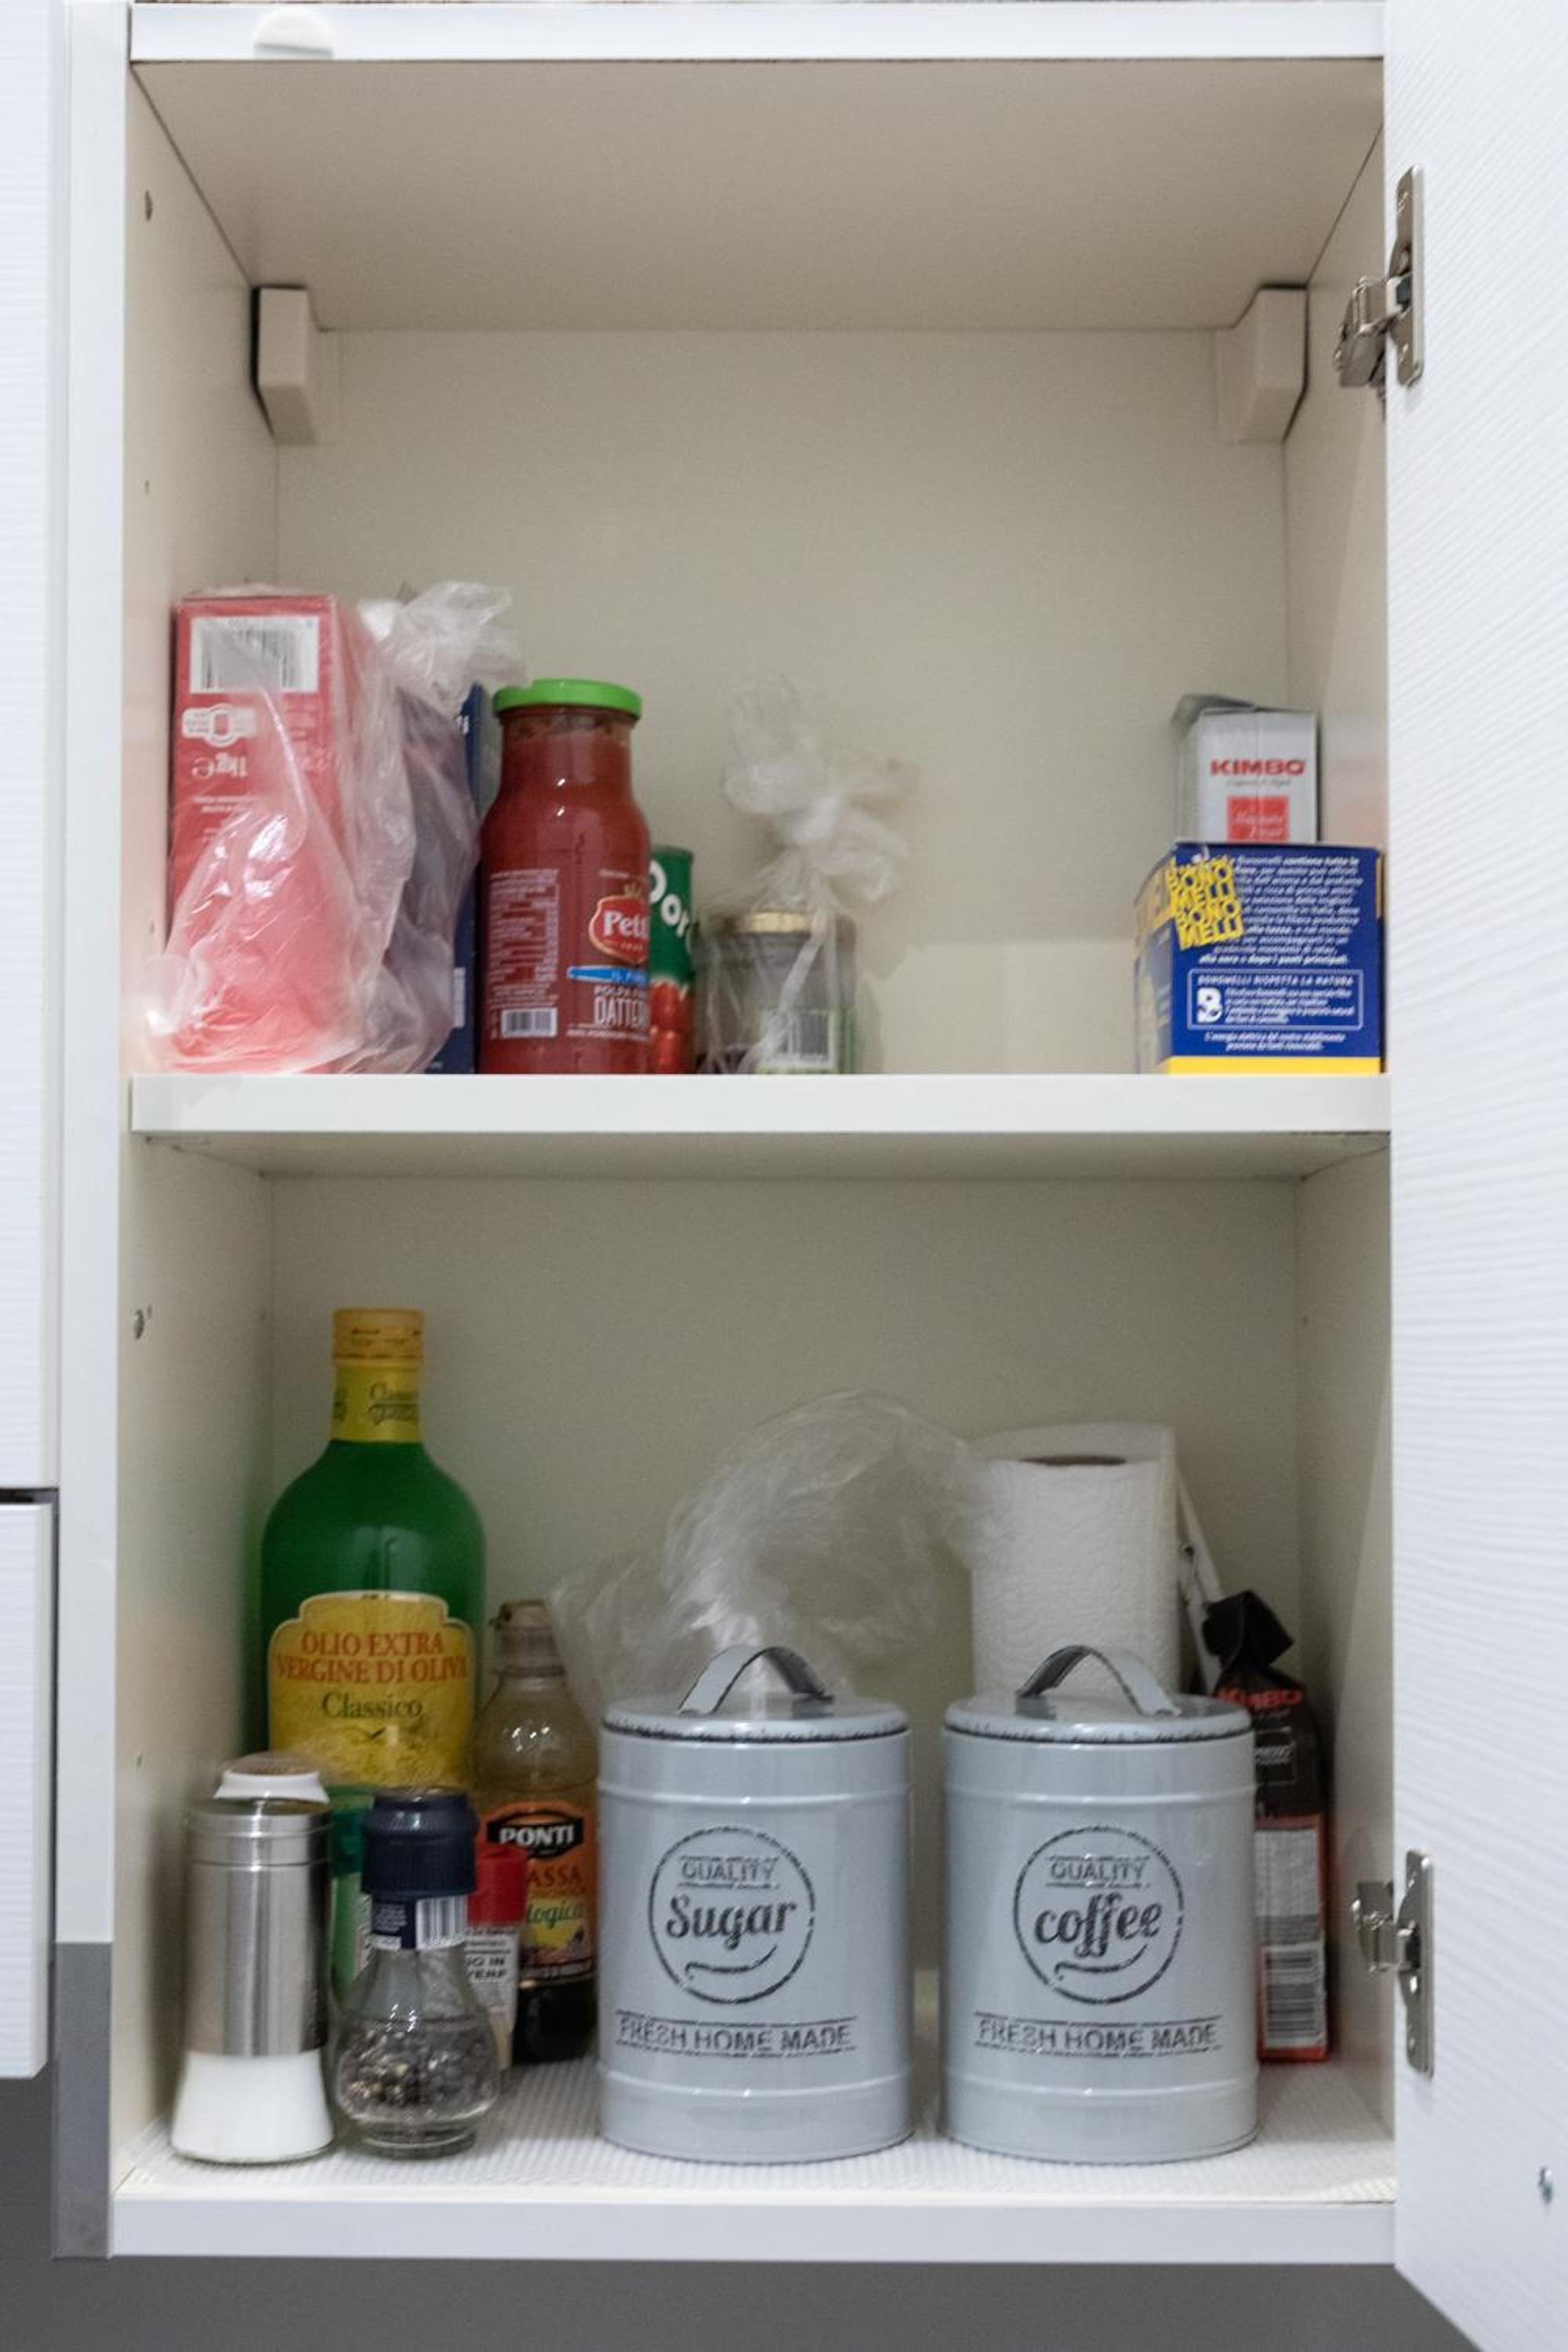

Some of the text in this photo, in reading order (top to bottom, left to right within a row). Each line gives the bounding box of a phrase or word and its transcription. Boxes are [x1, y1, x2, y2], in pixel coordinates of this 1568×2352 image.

[1210, 759, 1305, 777] KIMBO
[301, 1630, 445, 1657] OLIO EXTRA
[276, 1654, 370, 1683] VERGINE
[376, 1658, 405, 1683] DI
[322, 1691, 424, 1719] Classico
[499, 1824, 575, 1846] PONTI
[681, 1860, 778, 1882] QUALITY
[1049, 1860, 1148, 1882] QUALITY
[666, 1893, 797, 1951] Sugar
[1034, 1891, 1163, 1958] coffee
[616, 2016, 851, 2052] FRESH HOME MADE
[978, 2017, 1218, 2052] FRESH HOME MADE
